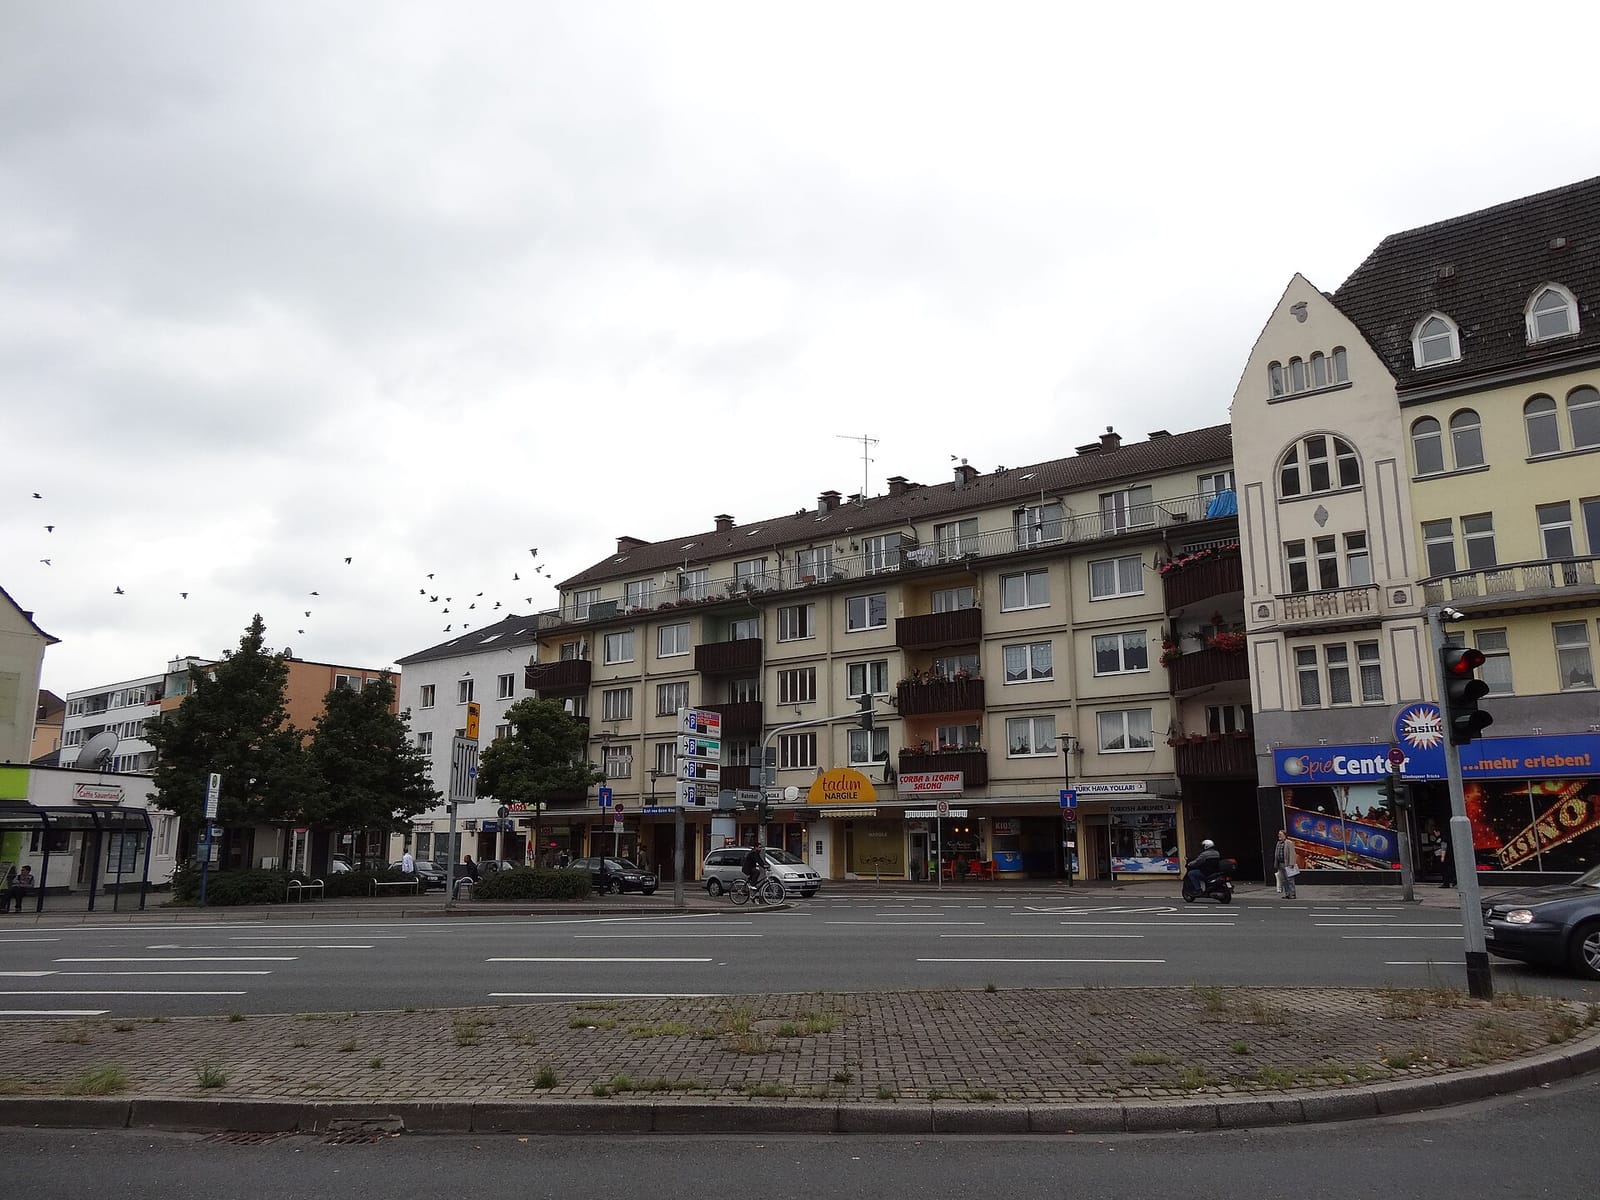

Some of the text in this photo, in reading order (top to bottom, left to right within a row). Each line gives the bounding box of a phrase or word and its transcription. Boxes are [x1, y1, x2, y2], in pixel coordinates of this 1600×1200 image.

[1523, 753, 1592, 768] erleben!
[825, 791, 858, 800] NARGILE
[1092, 784, 1109, 792] HAVA
[1295, 815, 1389, 851] CASINO
[1501, 798, 1587, 864] CASINO
